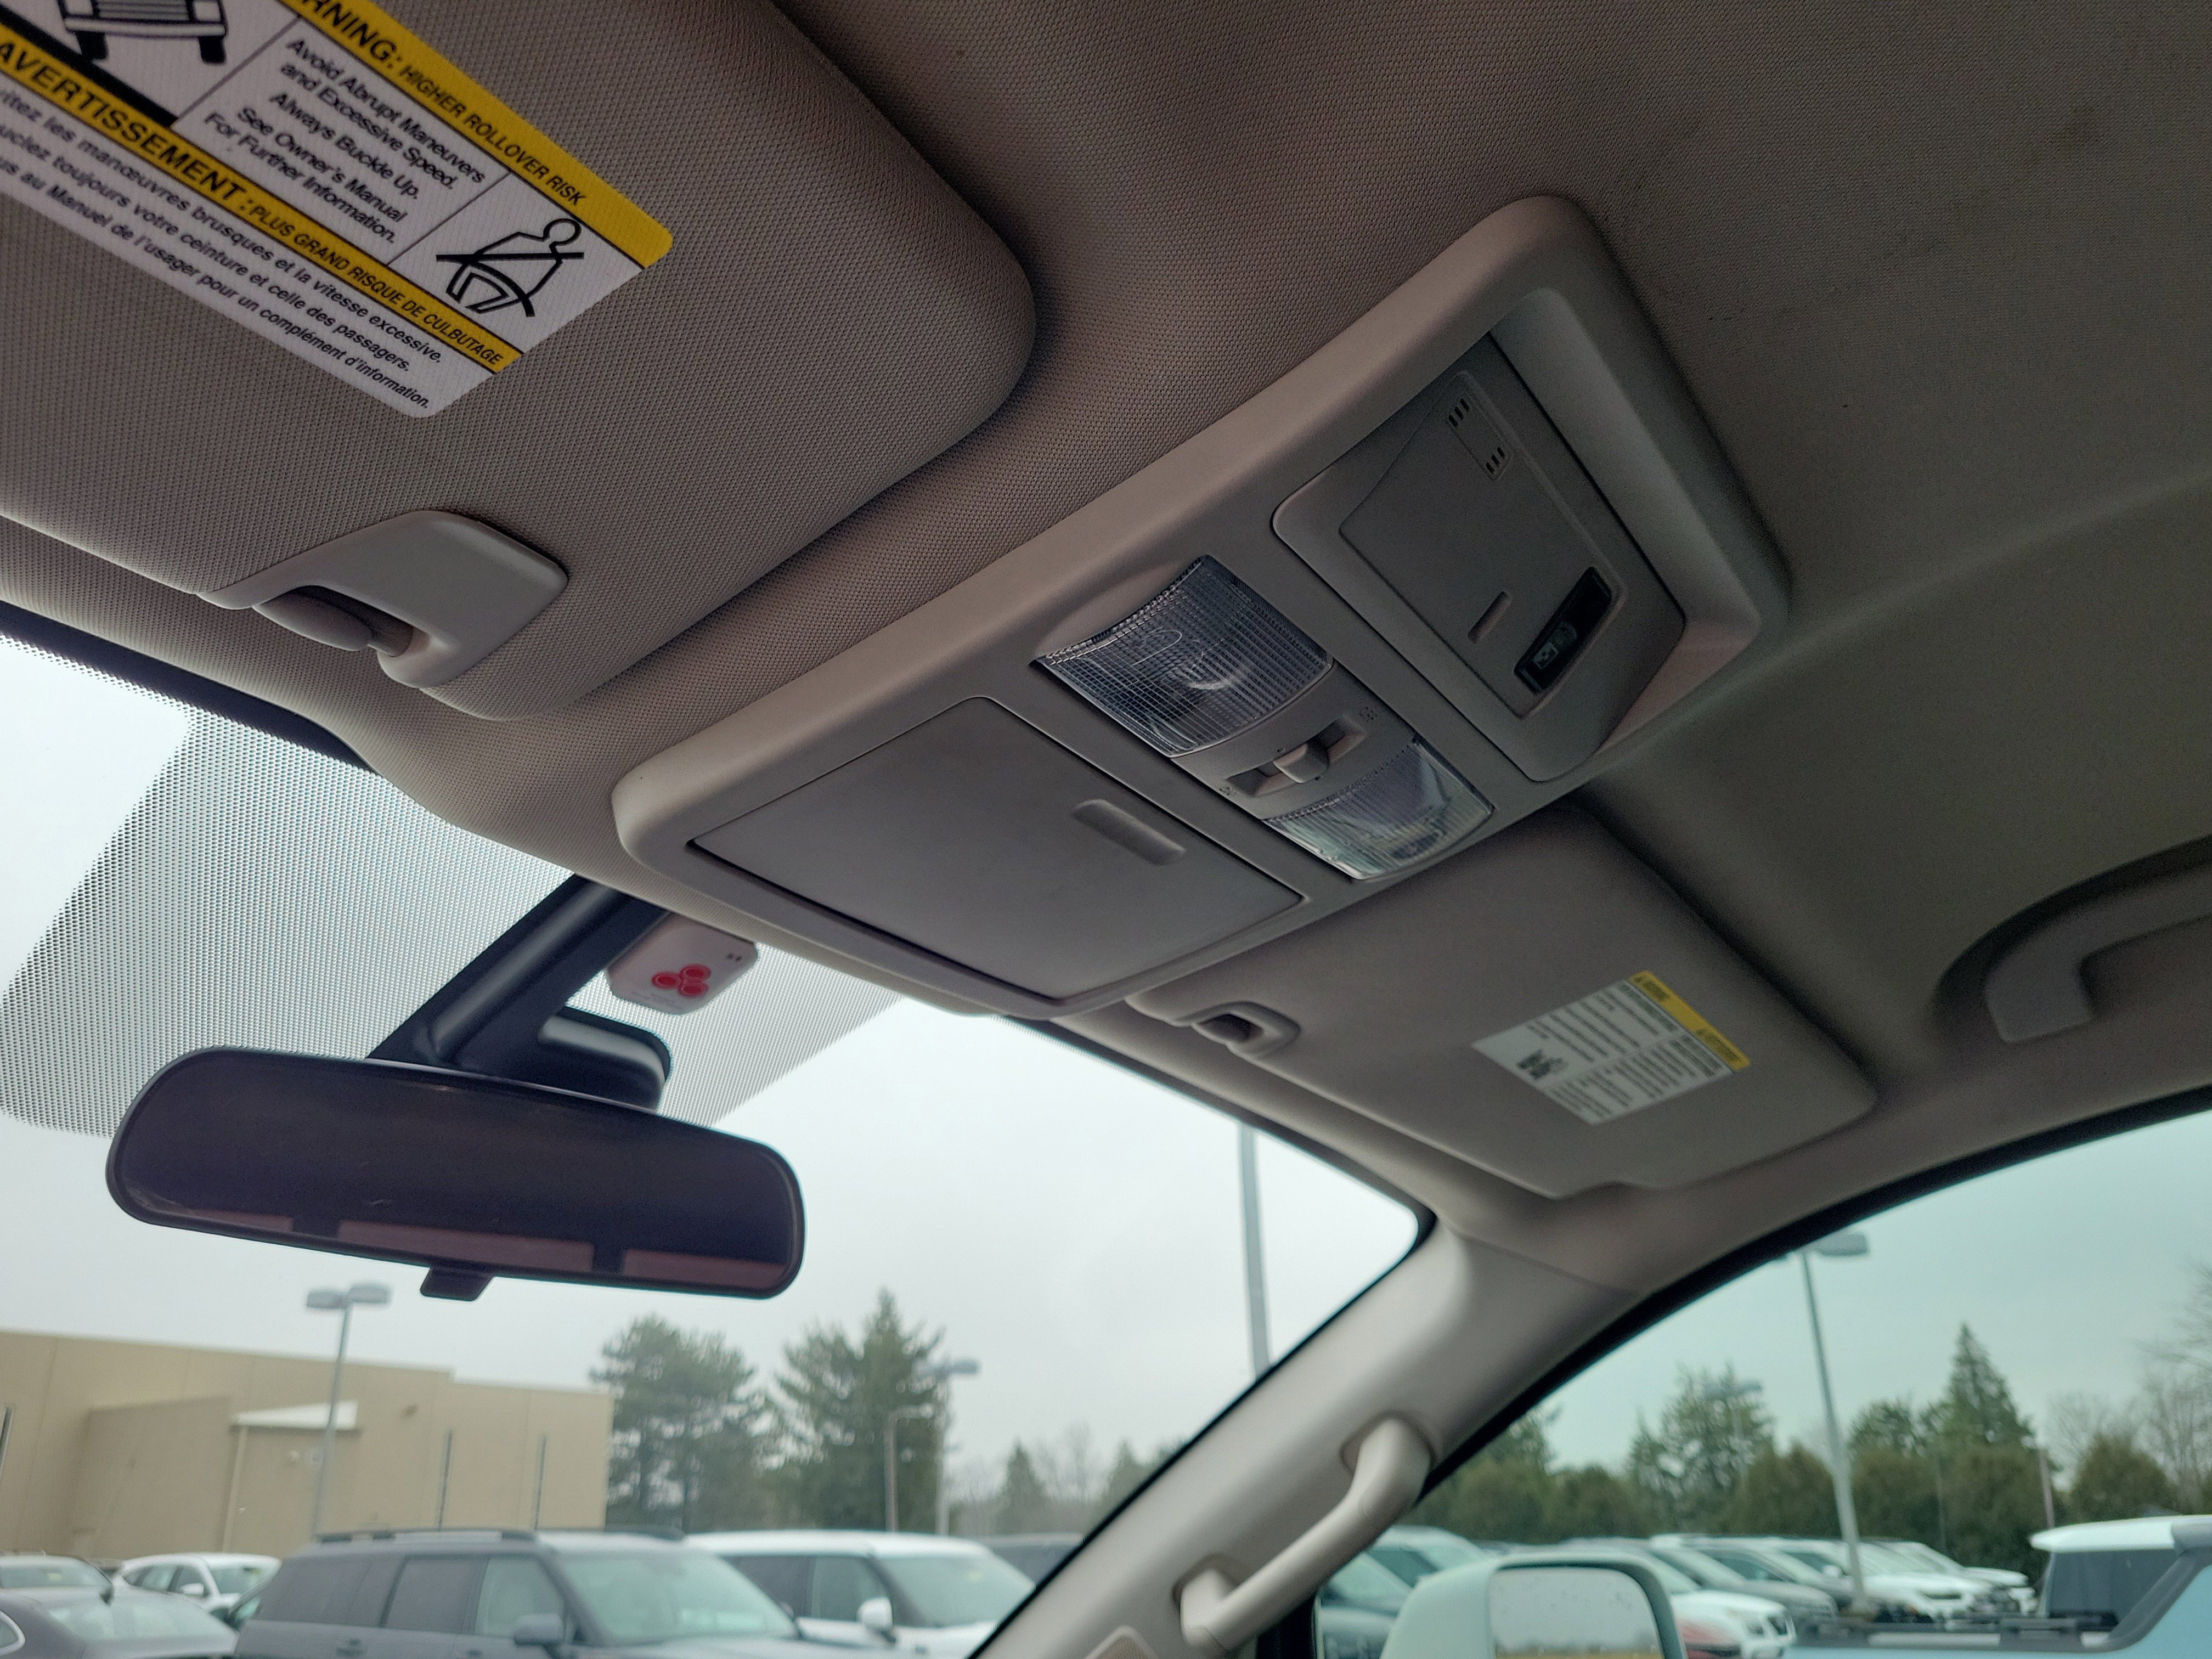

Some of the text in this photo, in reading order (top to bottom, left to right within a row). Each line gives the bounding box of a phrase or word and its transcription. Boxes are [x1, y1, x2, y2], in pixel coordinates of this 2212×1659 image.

[204, 112, 396, 245] For Further Information.
[236, 106, 408, 223] See Owner's Manual
[269, 92, 420, 200] Always Buckle Up.
[280, 62, 459, 190] and Excessive Speed.
[287, 40, 486, 184] Avoid Abrupt Maneuvers
[399, 64, 468, 119] HIGHER
[463, 113, 549, 179] ROLLOVER
[545, 176, 588, 206] RISK
[20, 172, 47, 191] au
[47, 183, 113, 227] Manuel
[111, 223, 134, 241] de
[134, 234, 201, 276] l'usager
[196, 274, 239, 299] pour
[238, 295, 261, 312] un
[259, 307, 347, 360] complément
[344, 356, 430, 409] d'information.
[43, 116, 77, 143] les
[191, 206, 274, 263] brusques
[275, 257, 296, 273] et
[294, 267, 312, 284] la
[313, 280, 369, 318] vitesse
[368, 314, 441, 363] excessive.
[53, 154, 131, 207] toujours
[133, 203, 179, 236] votre
[180, 233, 250, 276] ceinture
[249, 273, 270, 288] et
[268, 285, 307, 309] celle
[306, 306, 336, 328] des
[332, 324, 409, 372] passagers.
[249, 205, 296, 237] PLUS
[294, 233, 351, 270] GRAND
[348, 266, 406, 306] RISQUE
[401, 300, 428, 318] DE
[423, 313, 505, 366] CULBUTAGE
